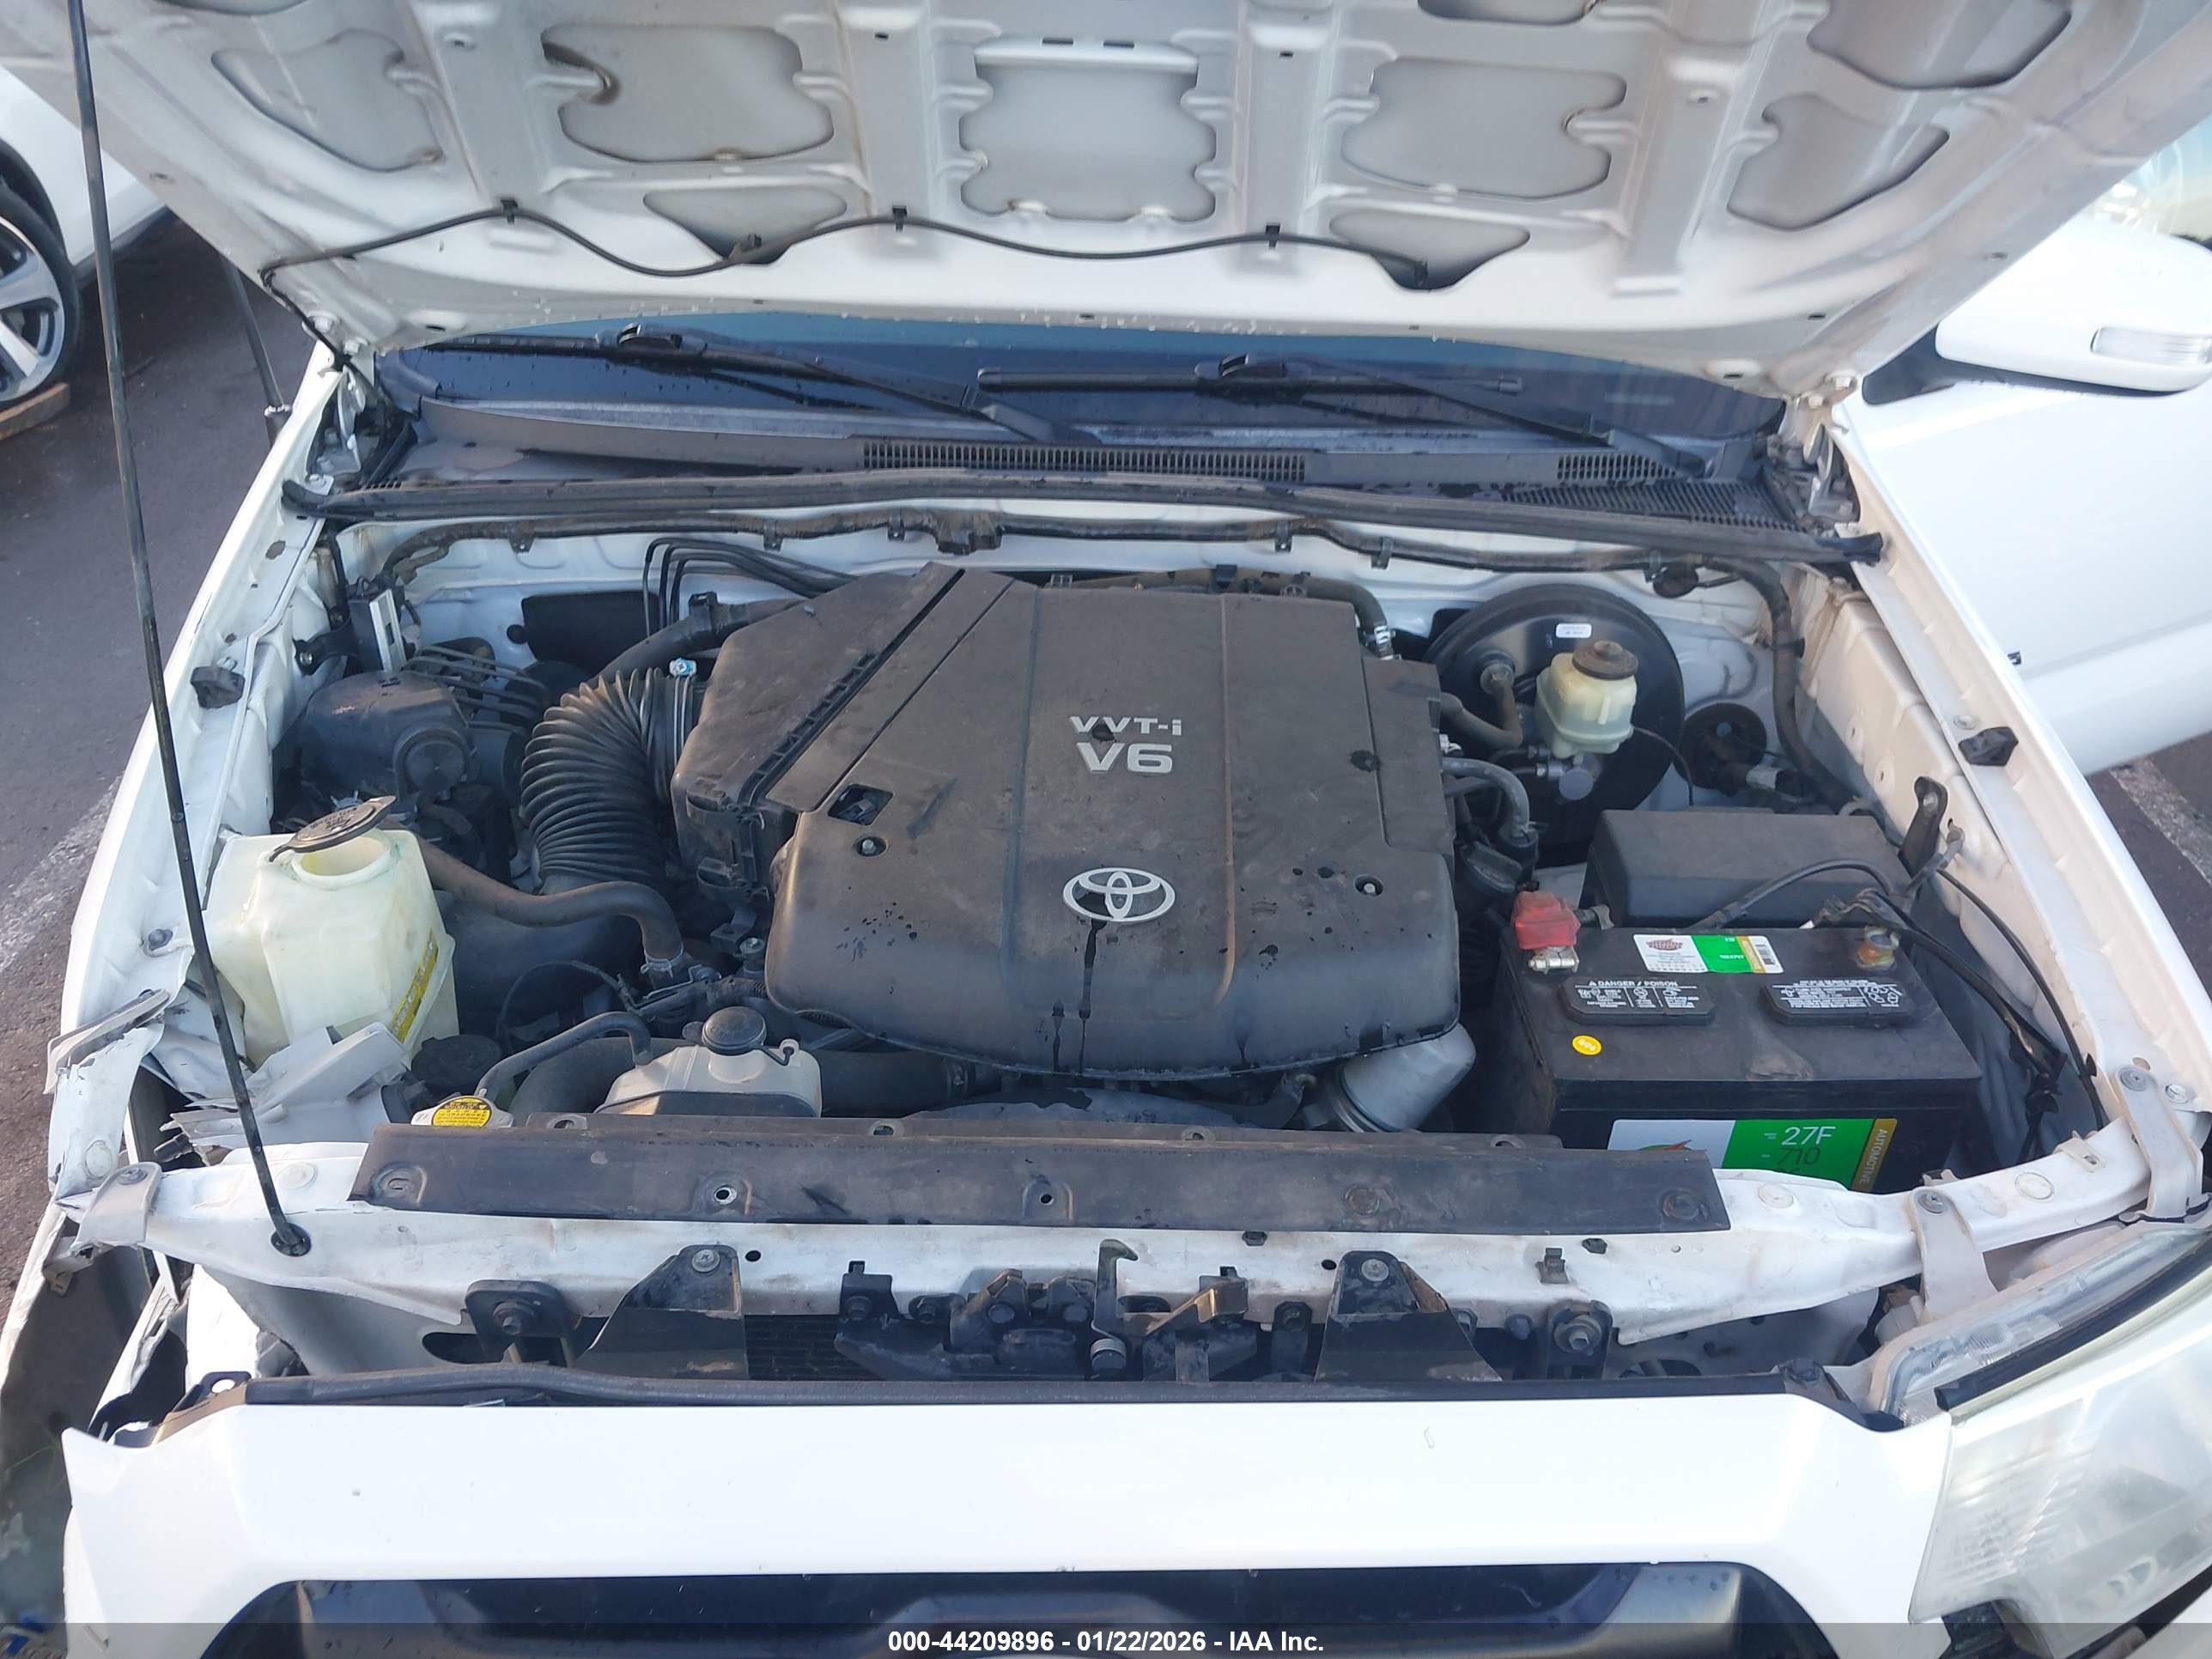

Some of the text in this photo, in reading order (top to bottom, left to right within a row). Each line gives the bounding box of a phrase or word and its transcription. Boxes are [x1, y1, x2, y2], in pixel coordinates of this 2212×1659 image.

[1069, 716, 1182, 736] VVT-i
[1076, 742, 1173, 774] V6
[1781, 1126, 1837, 1146] 27F
[1778, 1147, 1820, 1165] 710
[1859, 1128, 1888, 1184] AUTOMOTIVE
